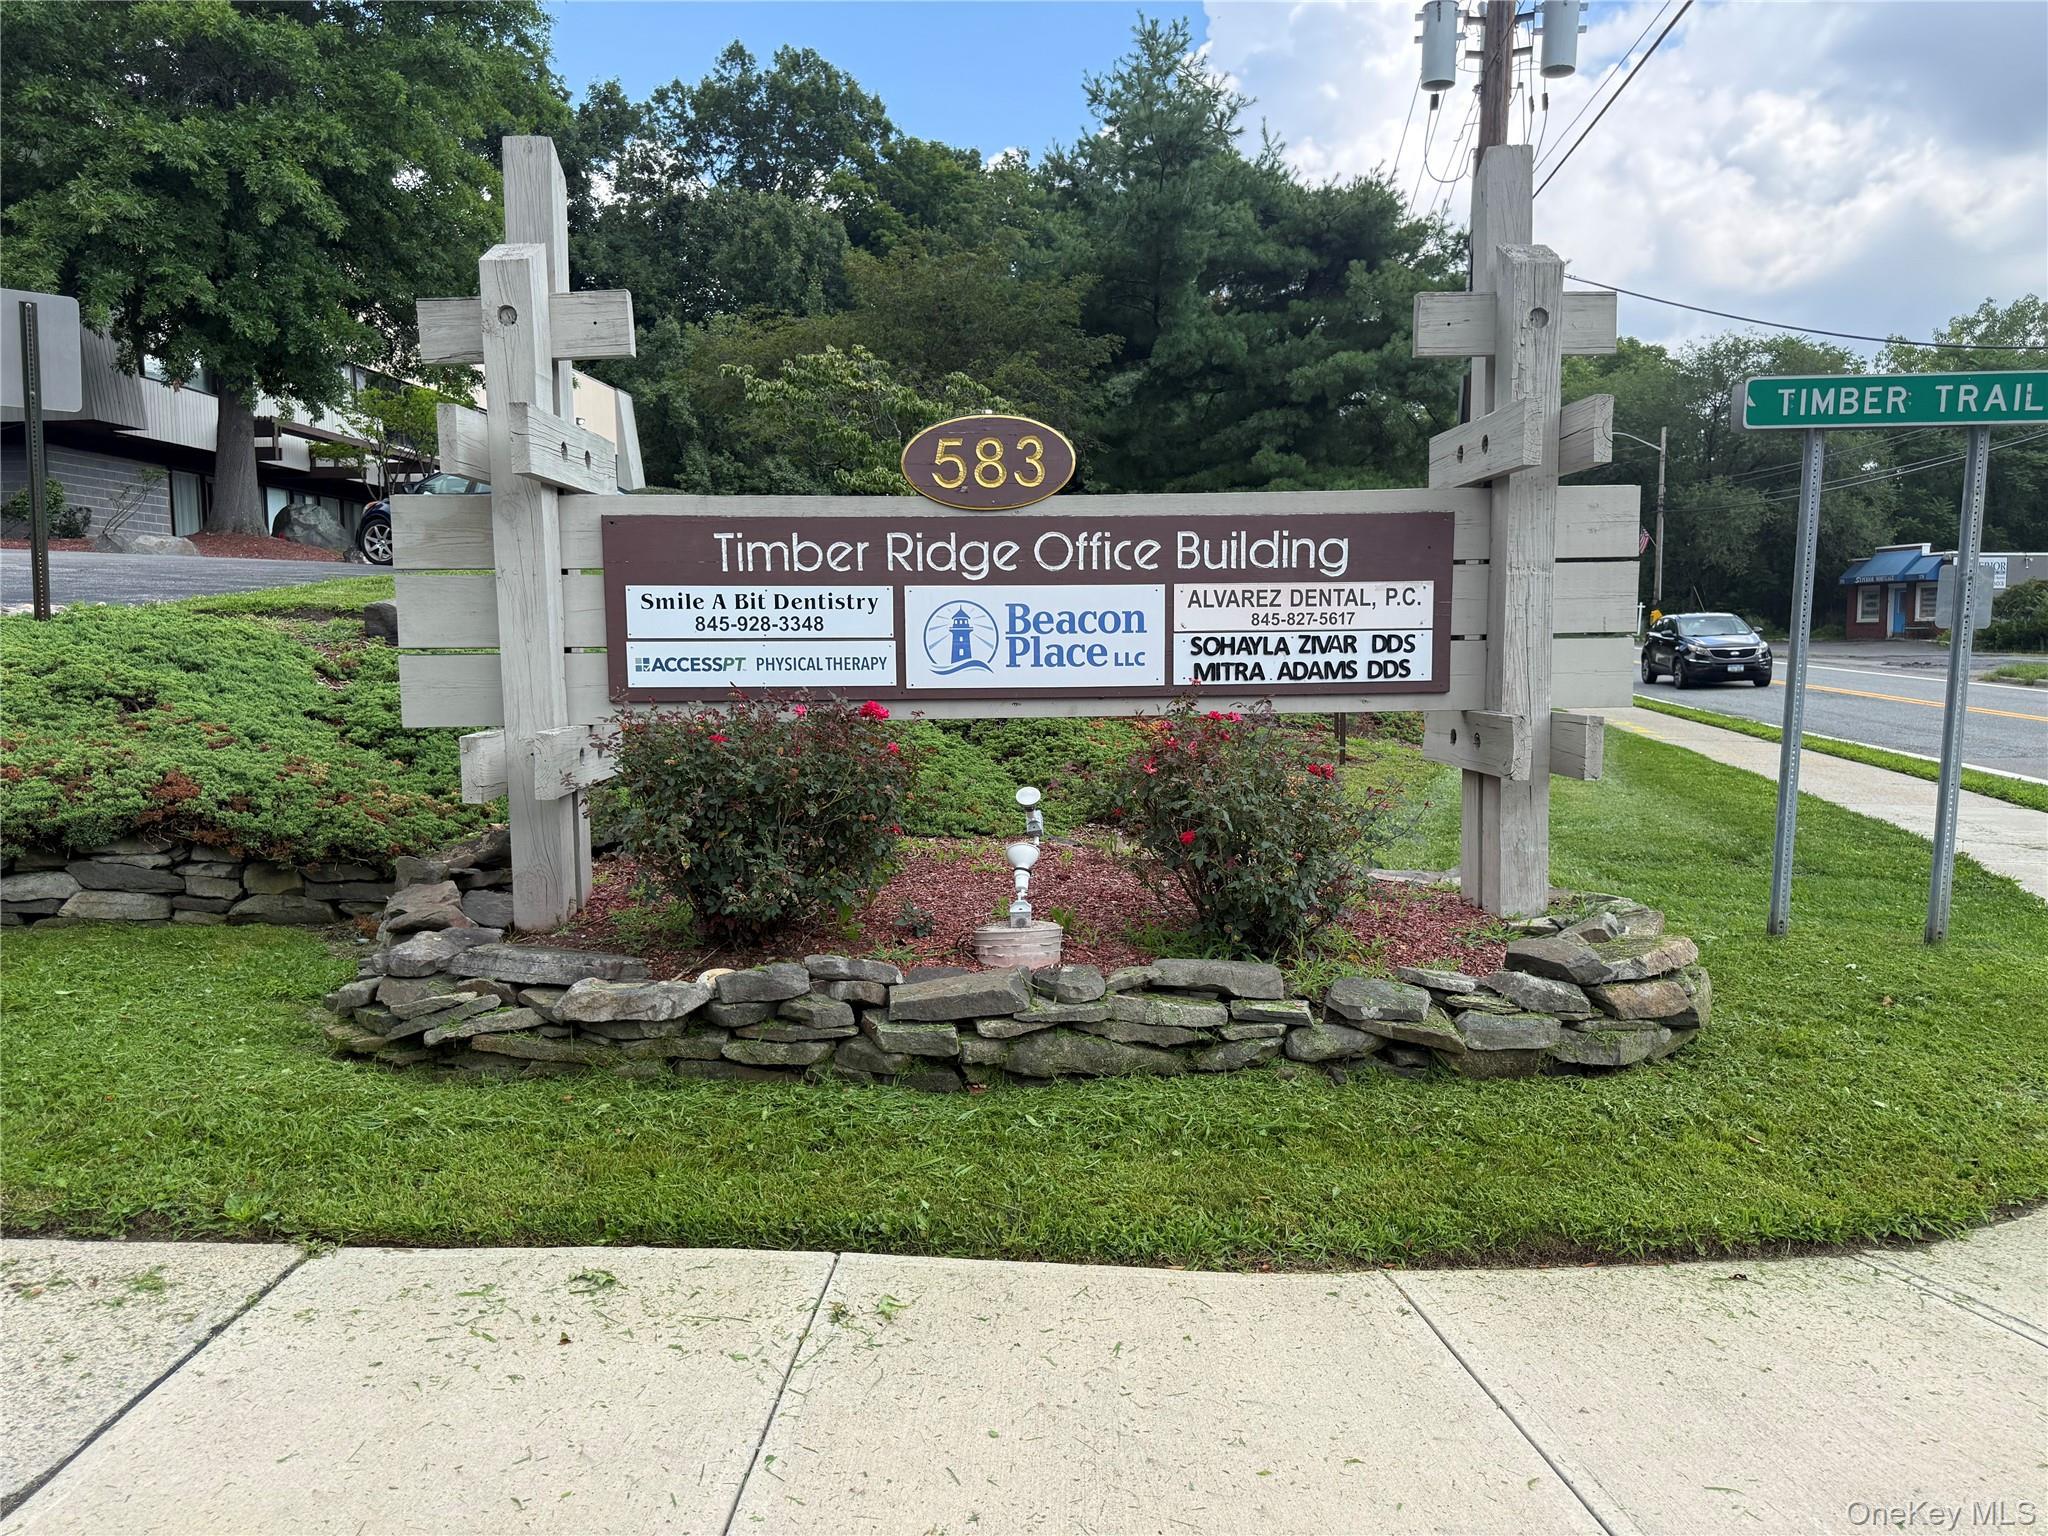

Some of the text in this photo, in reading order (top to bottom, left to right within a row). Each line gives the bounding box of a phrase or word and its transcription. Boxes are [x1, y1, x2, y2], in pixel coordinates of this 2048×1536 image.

[1778, 383, 2044, 416] TIMBER TRAIL
[932, 435, 1046, 489] 583
[713, 530, 1349, 580] Timber Ridge Office Building
[640, 592, 879, 614] Smile A Bit Dentistry
[1187, 587, 1422, 610] ALVAREZ DENTAL, P.C.
[695, 616, 824, 632] 845-928-3348
[1005, 602, 1147, 635] Beacon
[1251, 612, 1356, 626] 845-827-5617
[1005, 635, 1146, 668] Place LLC
[1190, 634, 1416, 656] SOHAYLA ZIVAR DDS
[651, 656, 888, 672] ACCESSPT PHYSICAL THERAPY
[1193, 659, 1411, 682] MITRA ADAMS DDS
